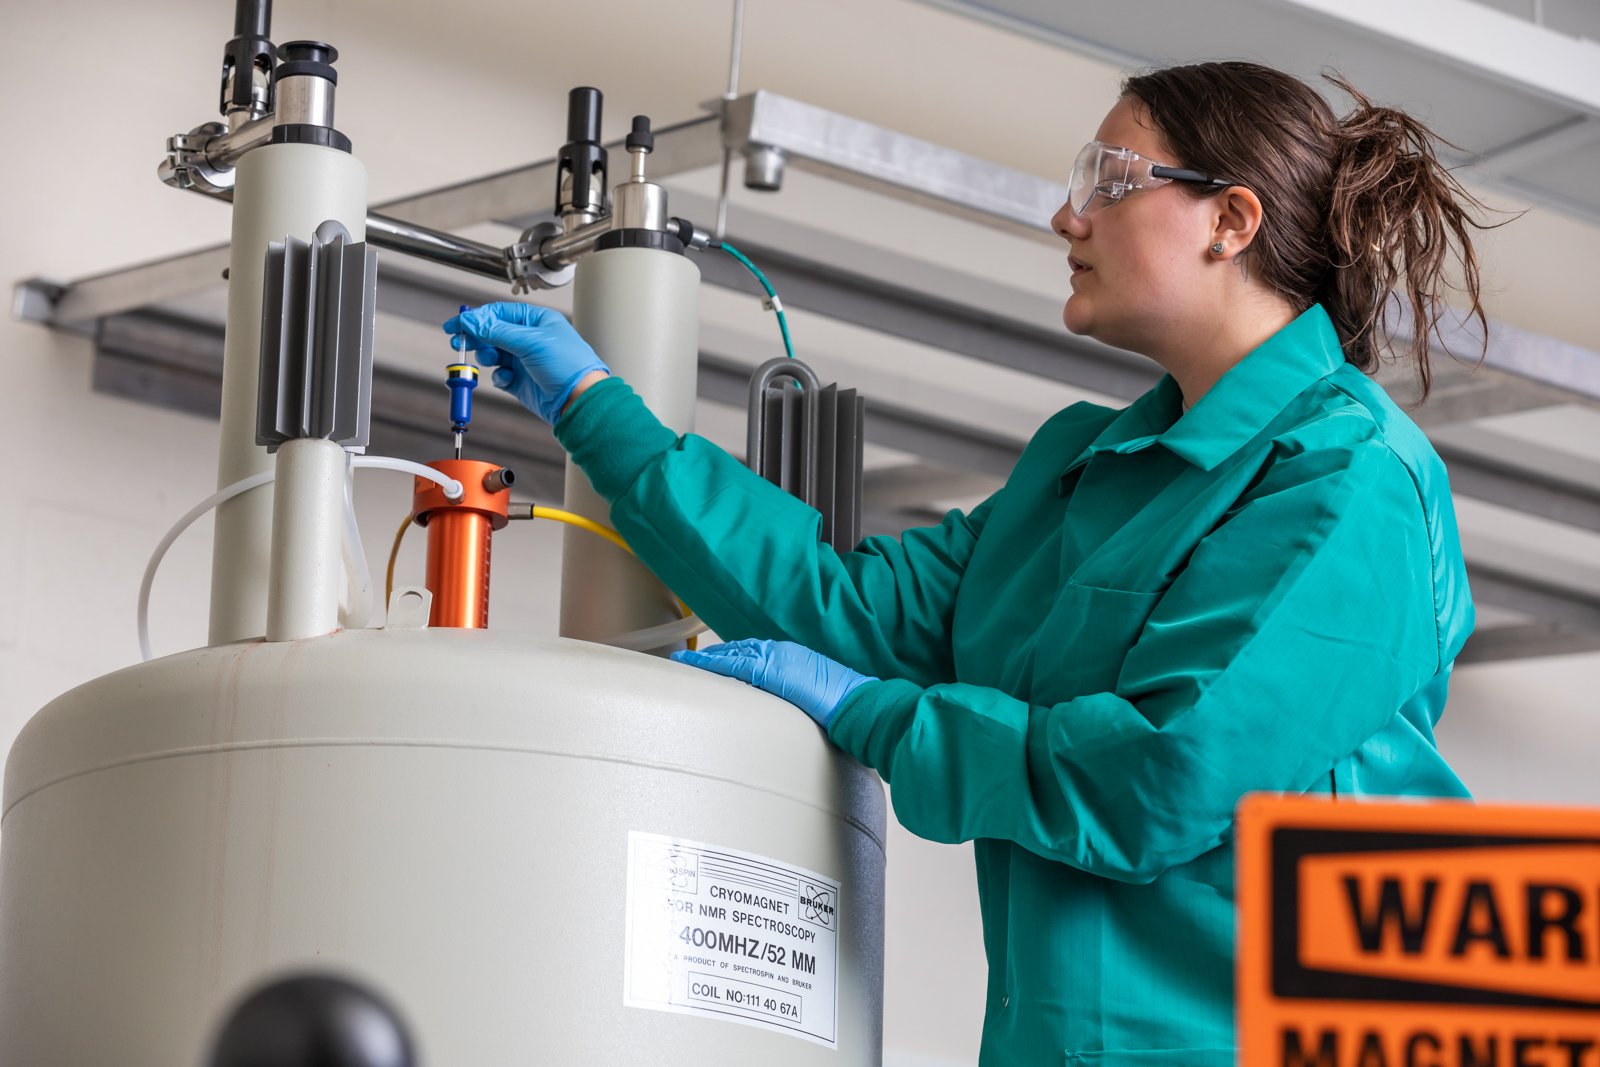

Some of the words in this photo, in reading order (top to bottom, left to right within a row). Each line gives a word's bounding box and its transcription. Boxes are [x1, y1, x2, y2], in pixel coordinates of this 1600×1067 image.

[709, 885, 790, 915] CRYOMAGNET
[800, 896, 834, 915] BRUKER
[1341, 873, 1600, 965] WAR
[667, 898, 694, 914] FOR
[699, 903, 727, 920] NMR
[732, 910, 816, 944] SPECTROSCOPY
[679, 925, 787, 966] 400MHZ/52
[791, 949, 816, 975] MM
[673, 953, 679, 961] A
[683, 955, 716, 967] PRODUCT
[720, 961, 729, 969] OF
[733, 964, 775, 980] SPECTROSPIN
[777, 974, 790, 984] AND
[792, 978, 812, 991] BRUKER
[692, 982, 721, 999] COIL
[763, 998, 777, 1011] 40
[780, 1002, 798, 1018] 67A
